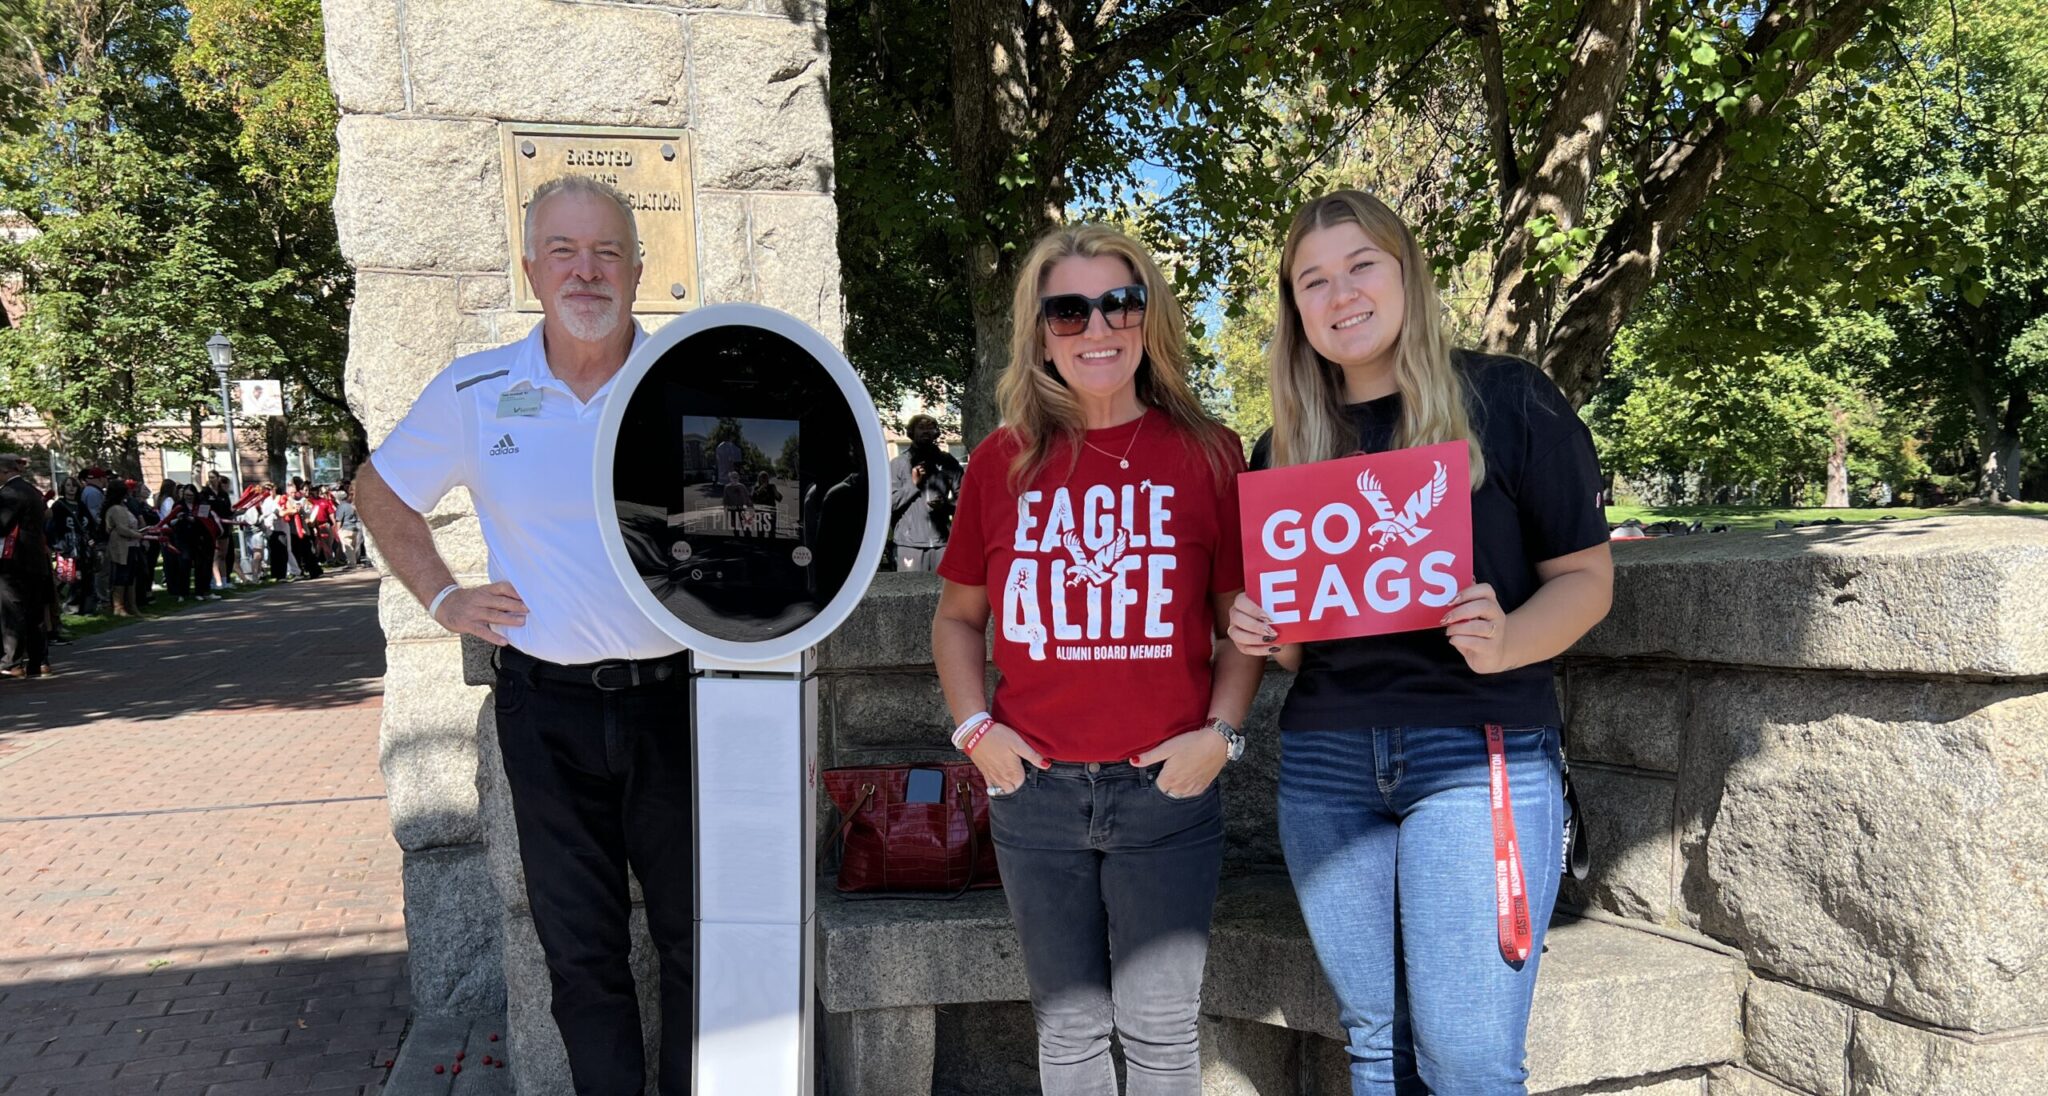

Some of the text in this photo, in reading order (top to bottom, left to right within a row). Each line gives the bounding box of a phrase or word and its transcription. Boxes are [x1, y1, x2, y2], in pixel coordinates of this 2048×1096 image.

[566, 149, 633, 167] ERECTED
[629, 191, 682, 211] CIATION
[489, 446, 520, 456] adidas
[1013, 484, 1176, 552] EAGLE
[1261, 502, 1361, 561] GO
[1259, 550, 1459, 625] EAGS
[1056, 644, 1173, 660] ALUMNI BOARD MEMBER
[1491, 754, 1504, 809] WASHINGTON
[1496, 859, 1510, 916] WASHINGTON
[1513, 896, 1527, 936] EASTERN
